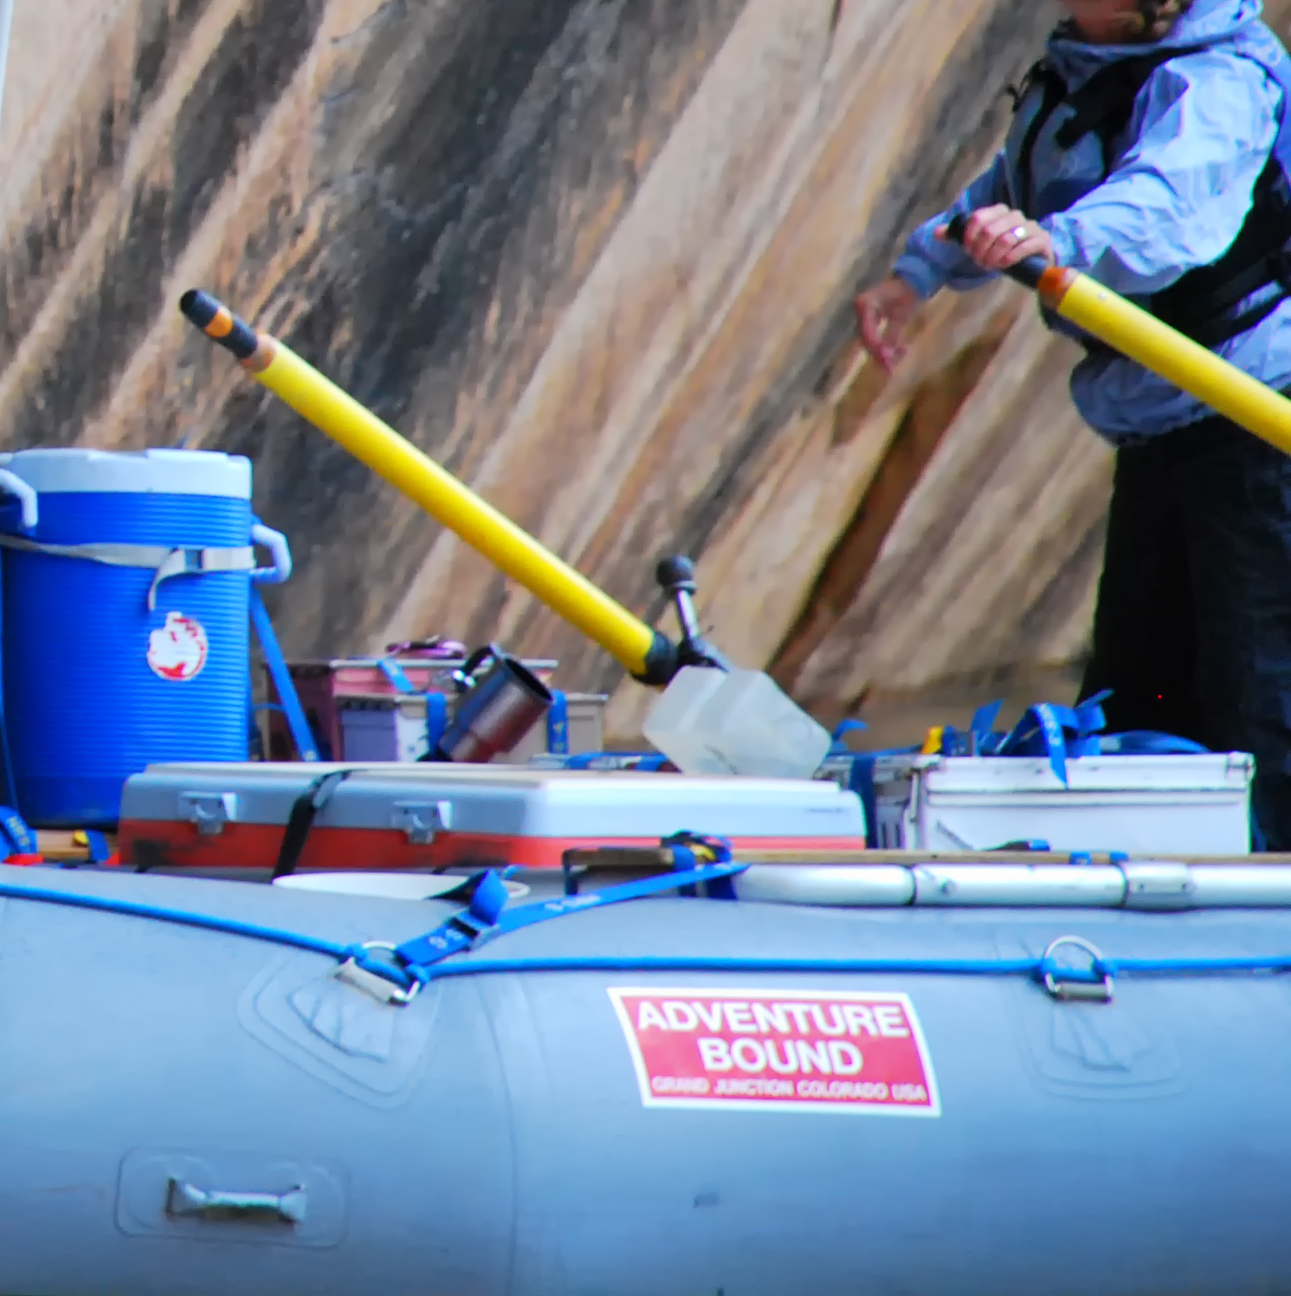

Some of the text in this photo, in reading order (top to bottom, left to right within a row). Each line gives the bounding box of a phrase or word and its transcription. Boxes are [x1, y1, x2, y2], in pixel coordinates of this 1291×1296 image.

[637, 1000, 909, 1038] ADVENTURE
[697, 1037, 864, 1075] BOUND
[651, 1075, 927, 1102] GRAND JUNCTION COLORADO USA
